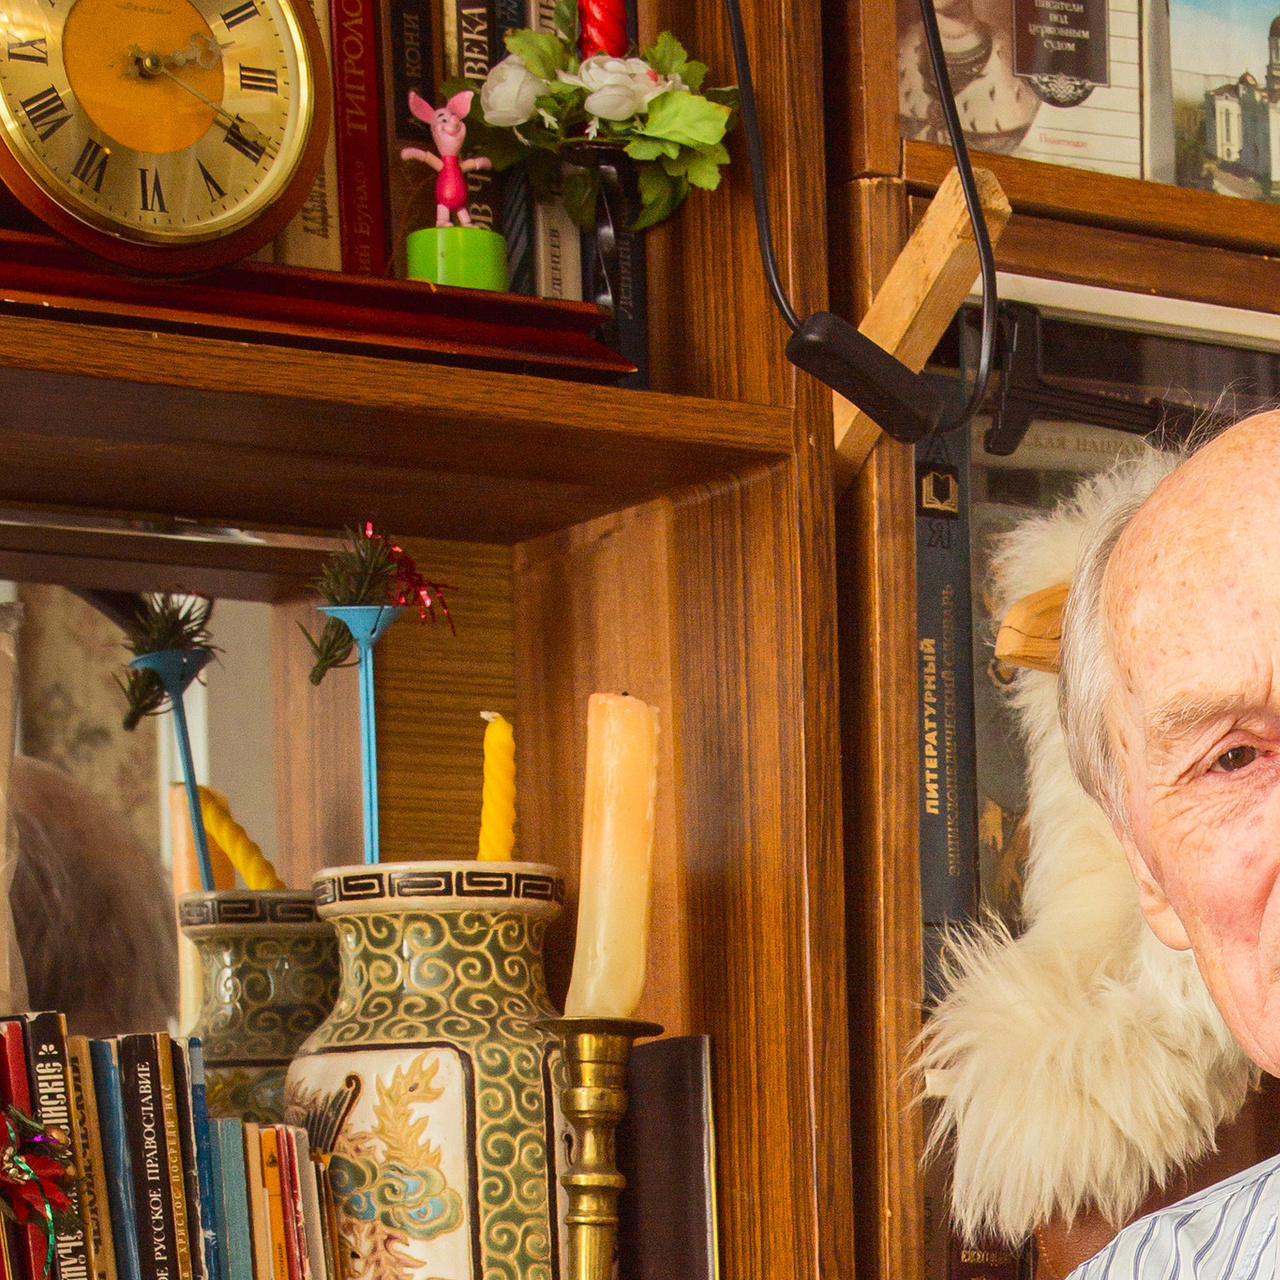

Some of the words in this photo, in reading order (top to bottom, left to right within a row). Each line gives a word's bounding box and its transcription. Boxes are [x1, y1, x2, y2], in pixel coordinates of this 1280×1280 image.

[462, 7, 489, 80] ВЕКА
[239, 63, 278, 94] III
[138, 167, 169, 213] VI
[135, 1060, 162, 1182] ПРАВОСЛАВИЕ
[161, 1083, 173, 1109] НАС
[148, 1187, 169, 1266] РУССКОЕ
